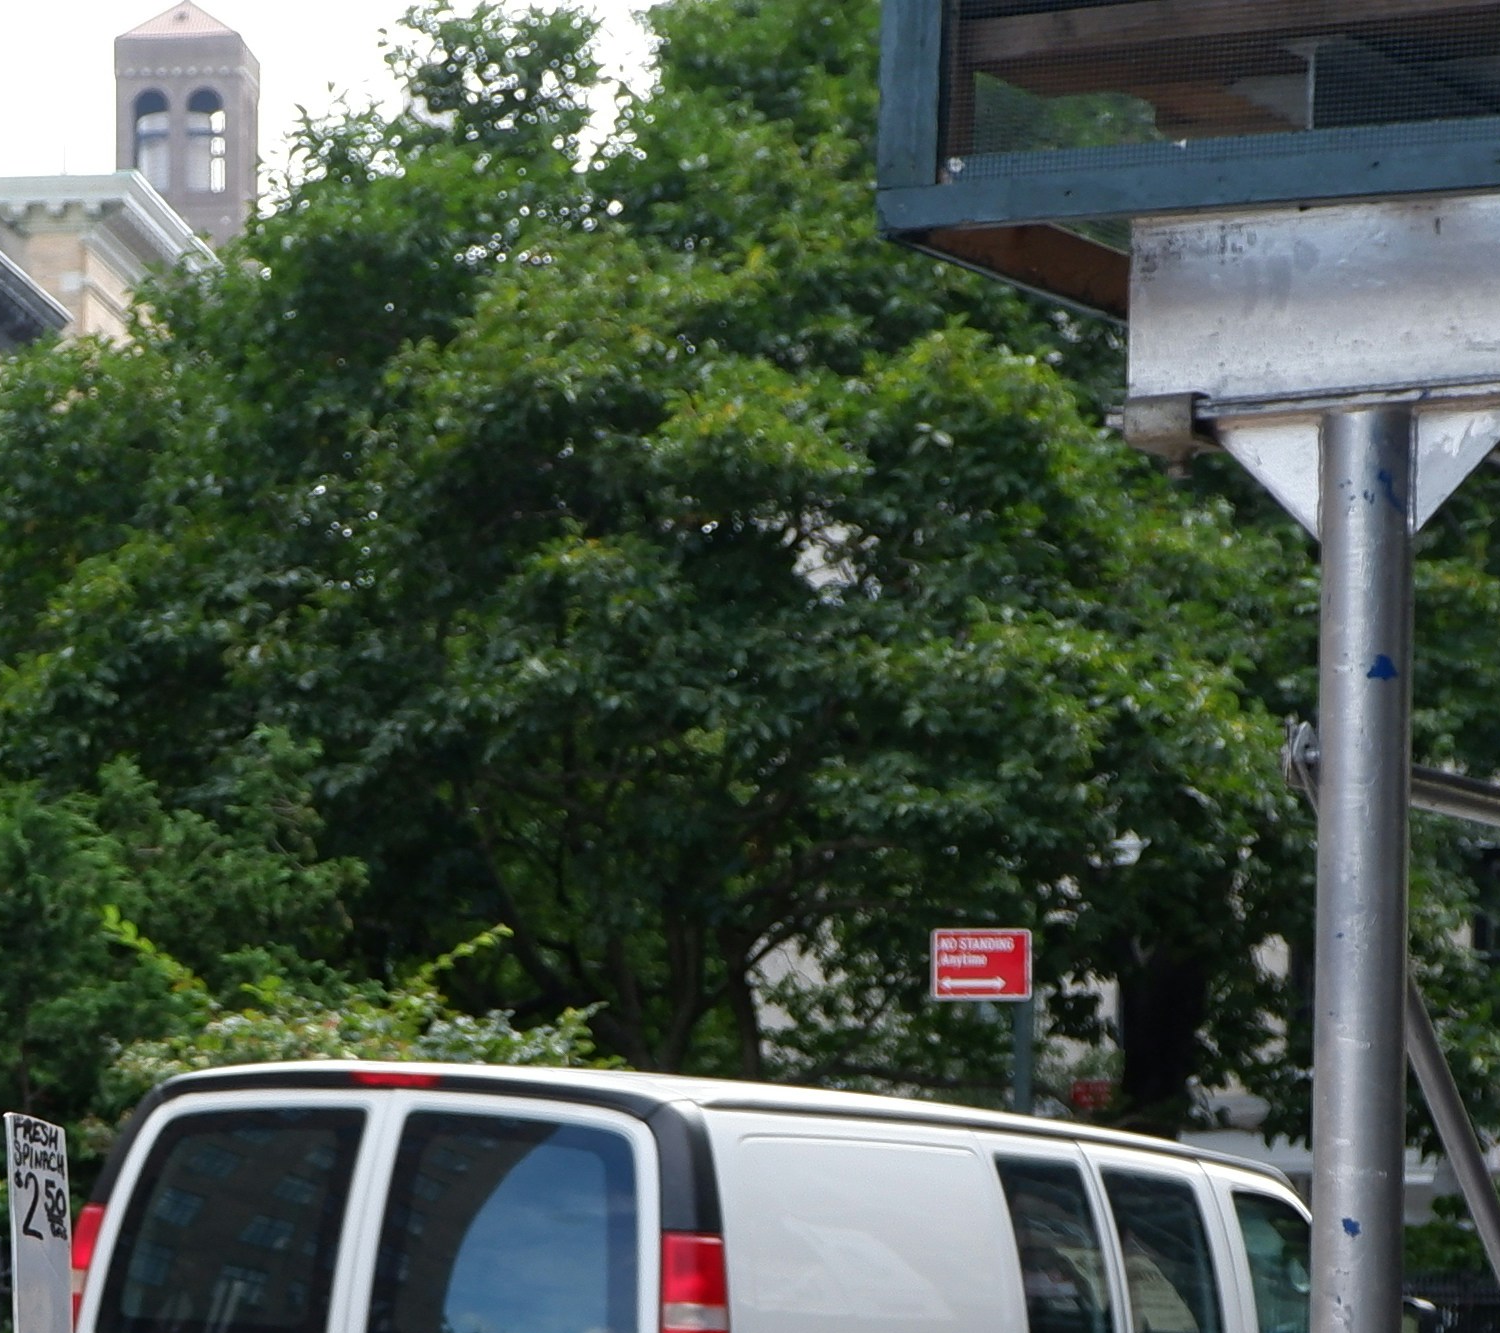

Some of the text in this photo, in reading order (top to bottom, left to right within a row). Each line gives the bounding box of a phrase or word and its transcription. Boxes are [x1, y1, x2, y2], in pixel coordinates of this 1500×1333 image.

[958, 937, 1016, 951] STANDING
[12, 1118, 59, 1152] FRESH
[13, 1141, 65, 1179] SPINACH
